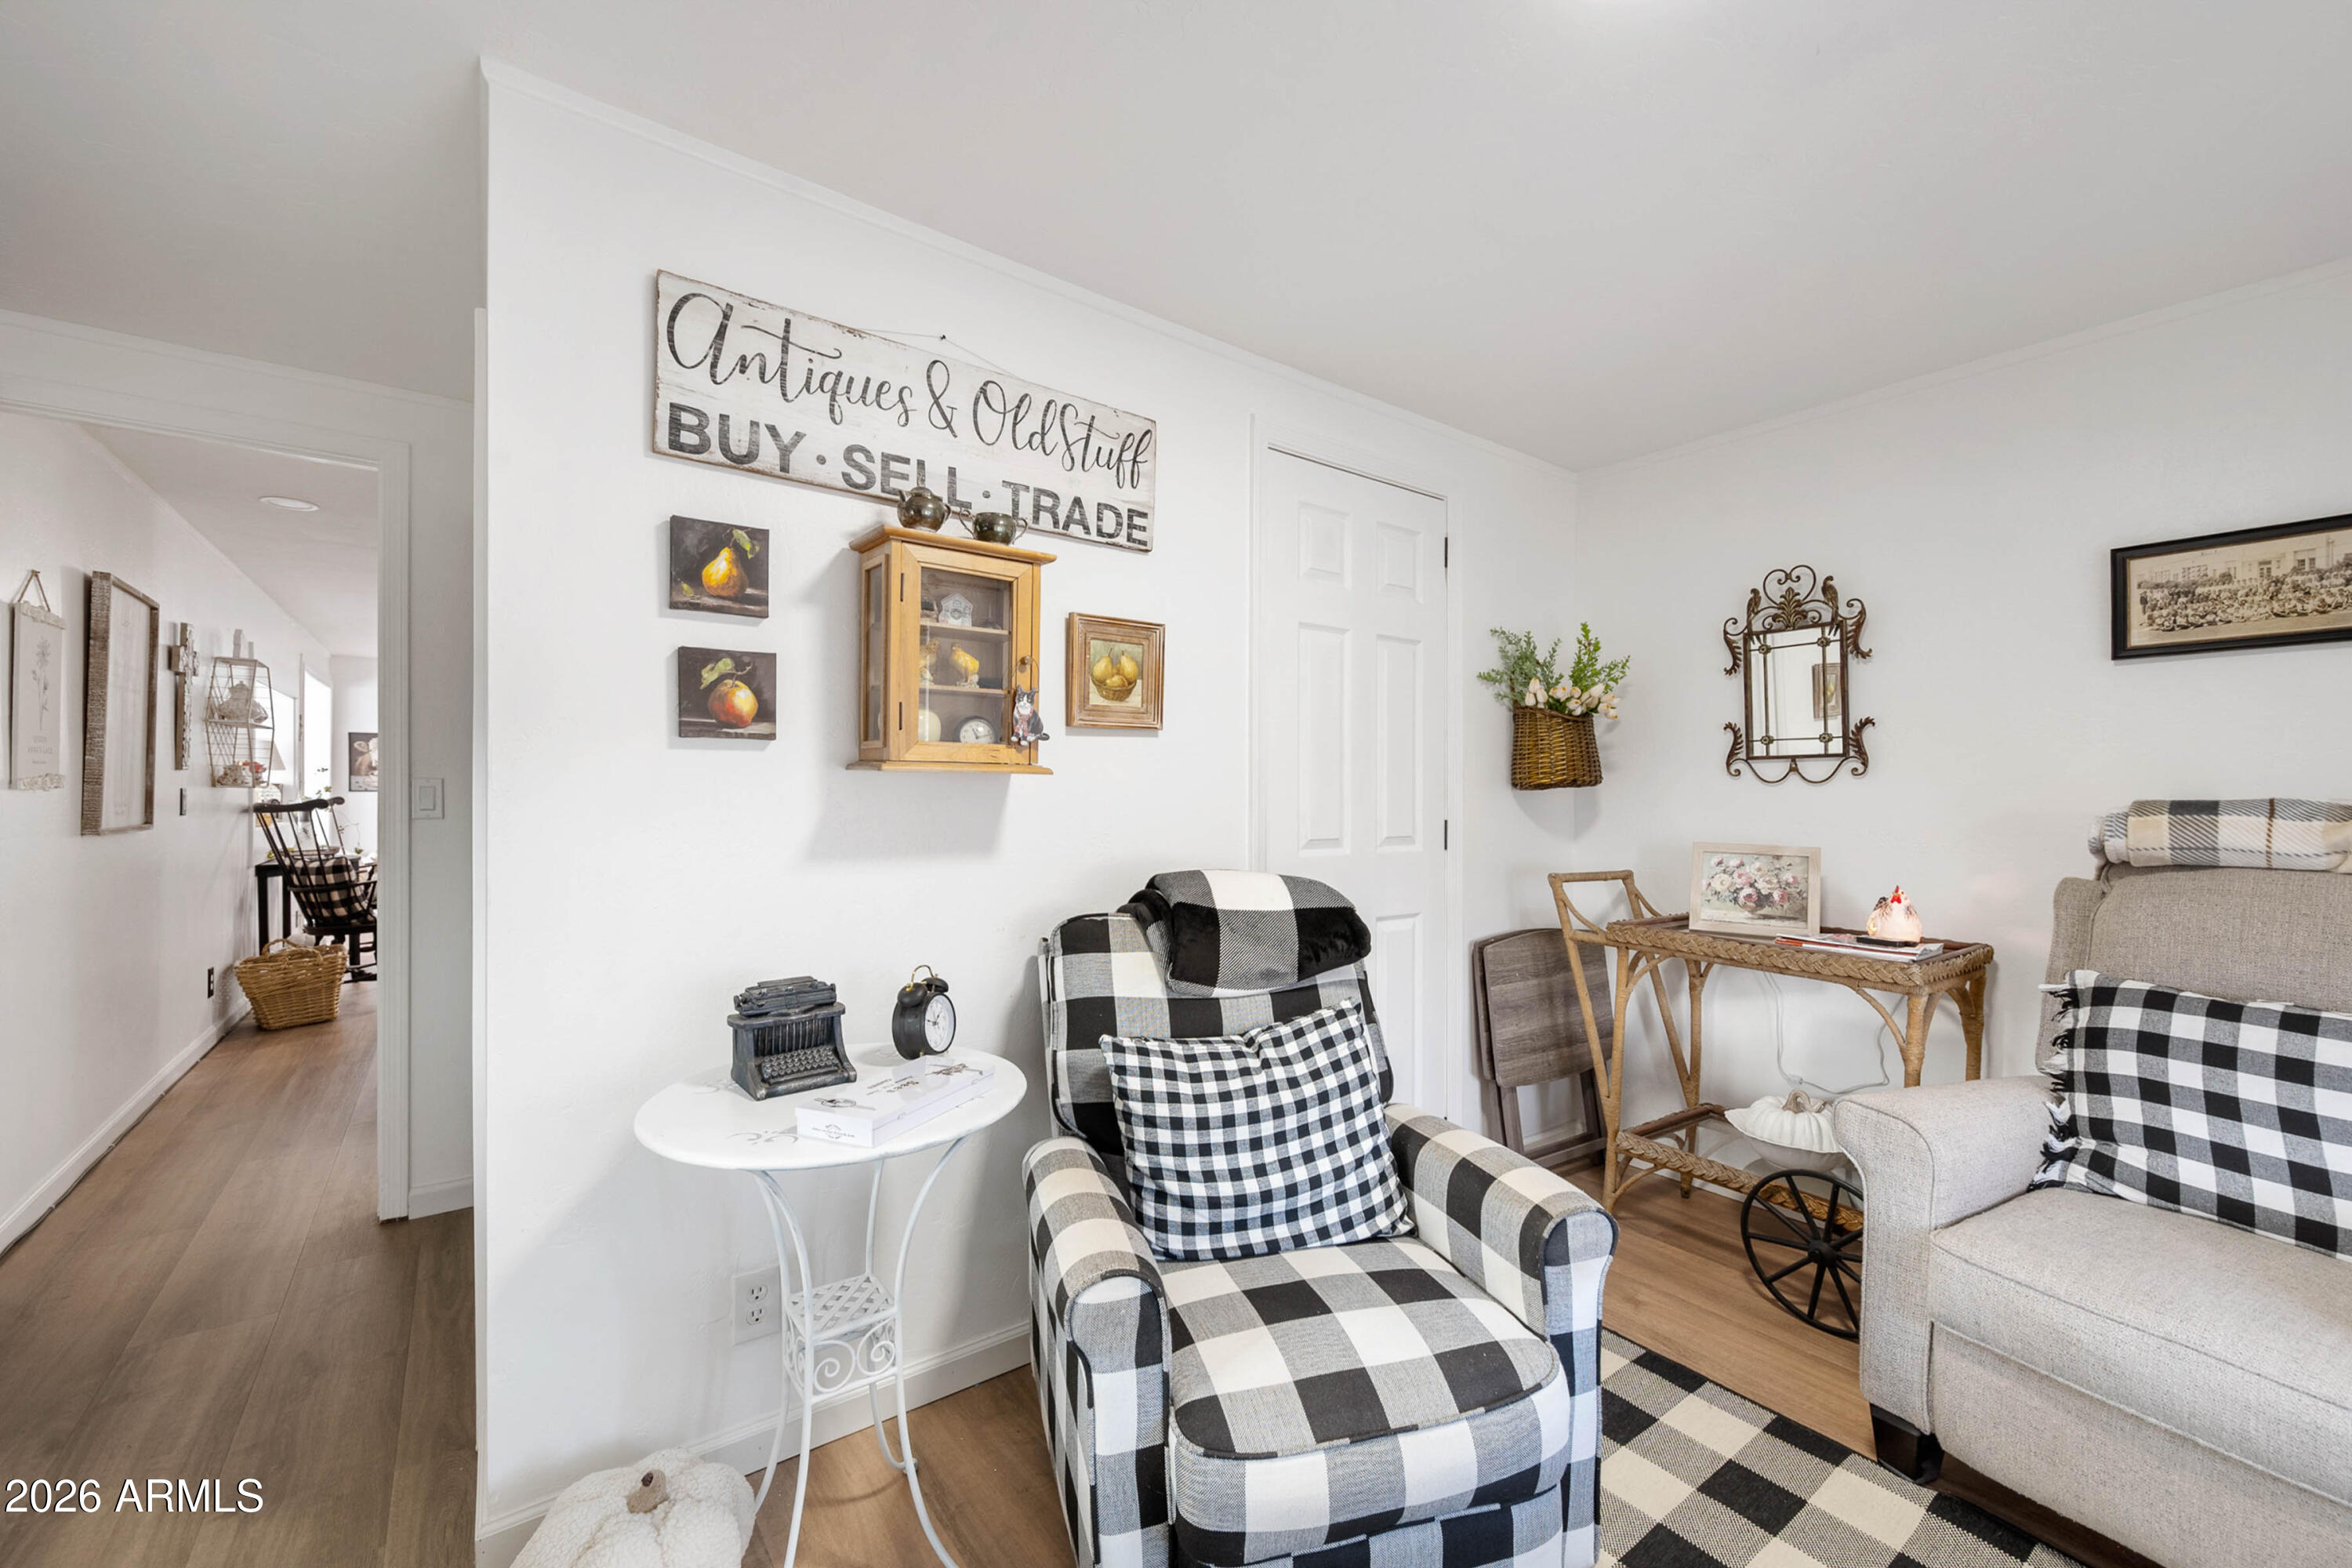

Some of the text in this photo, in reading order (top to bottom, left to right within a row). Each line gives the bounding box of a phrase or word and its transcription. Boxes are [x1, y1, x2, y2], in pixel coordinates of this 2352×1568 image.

[666, 292, 916, 427] Antiques
[926, 359, 958, 438] &
[667, 401, 807, 474] BUY
[1001, 479, 1149, 547] TRADE
